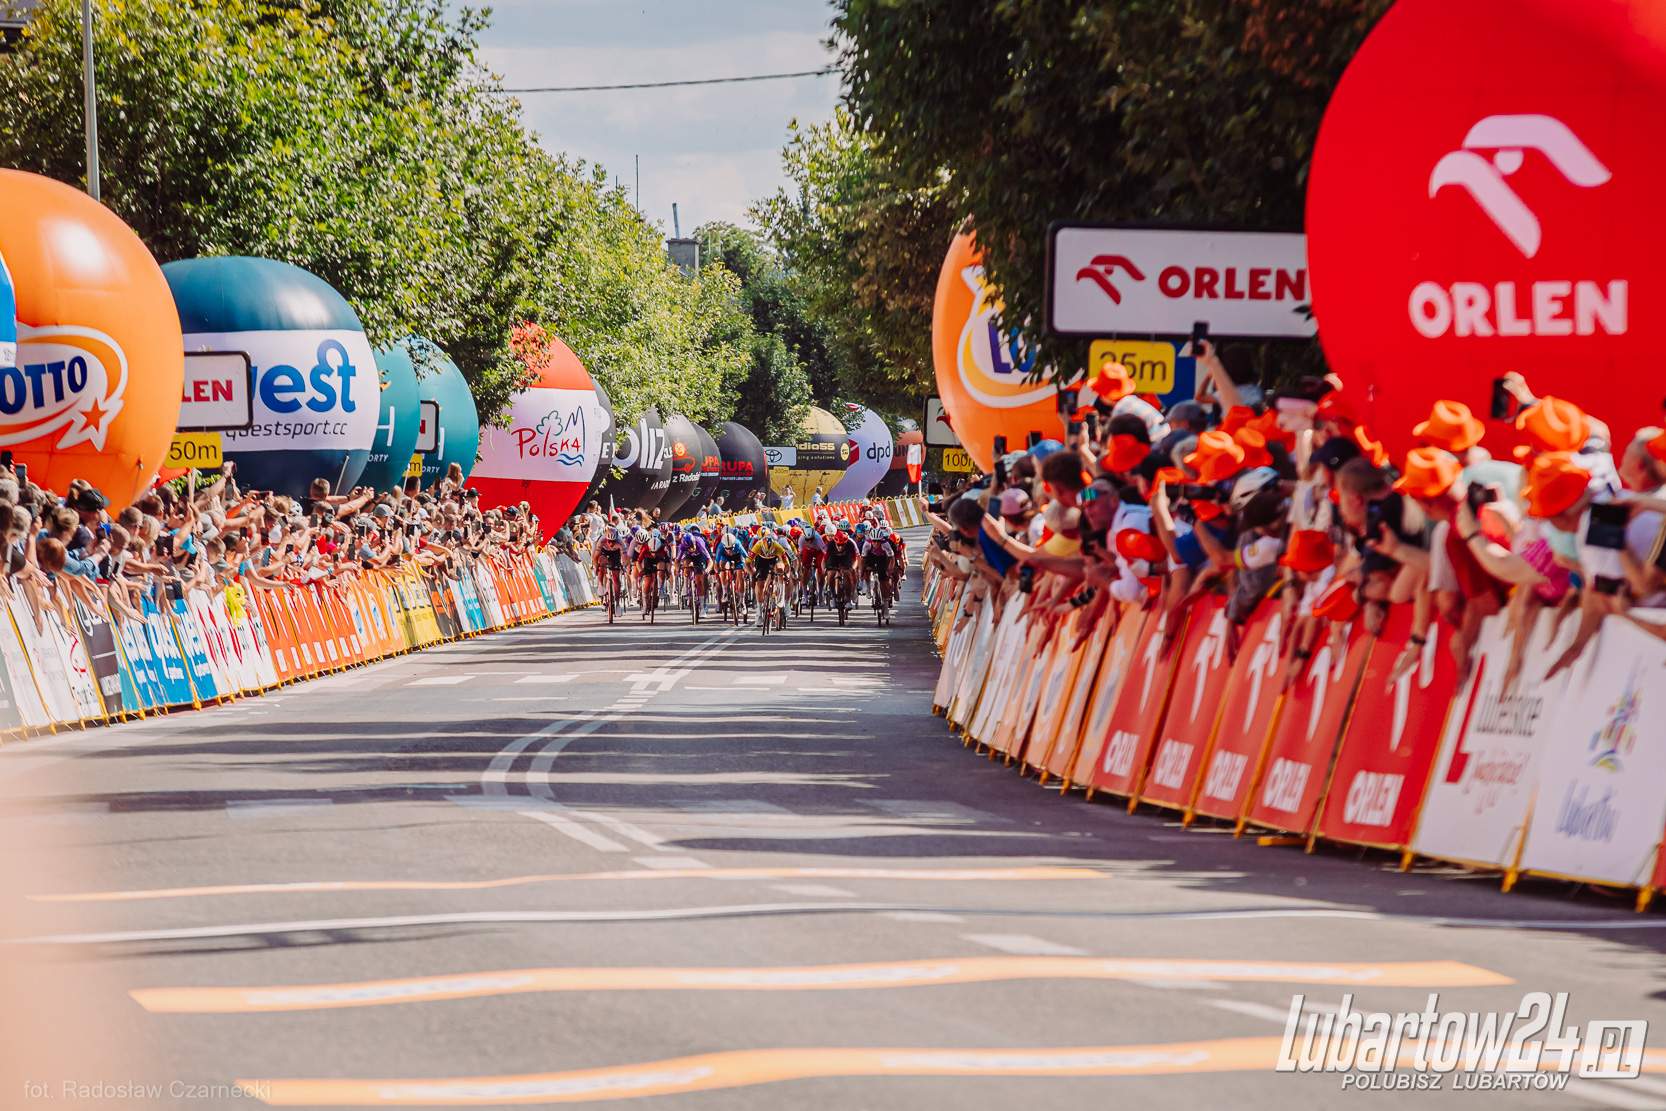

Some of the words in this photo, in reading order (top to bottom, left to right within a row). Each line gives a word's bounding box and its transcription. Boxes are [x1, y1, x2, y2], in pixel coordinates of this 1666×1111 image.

[1158, 265, 1306, 300] ORLEN
[1408, 279, 1629, 338] ORLEN
[0, 355, 88, 415] OTTO
[181, 379, 233, 402] LEN
[250, 338, 357, 414] est
[170, 441, 217, 461] 50m
[867, 442, 891, 463] dpd
